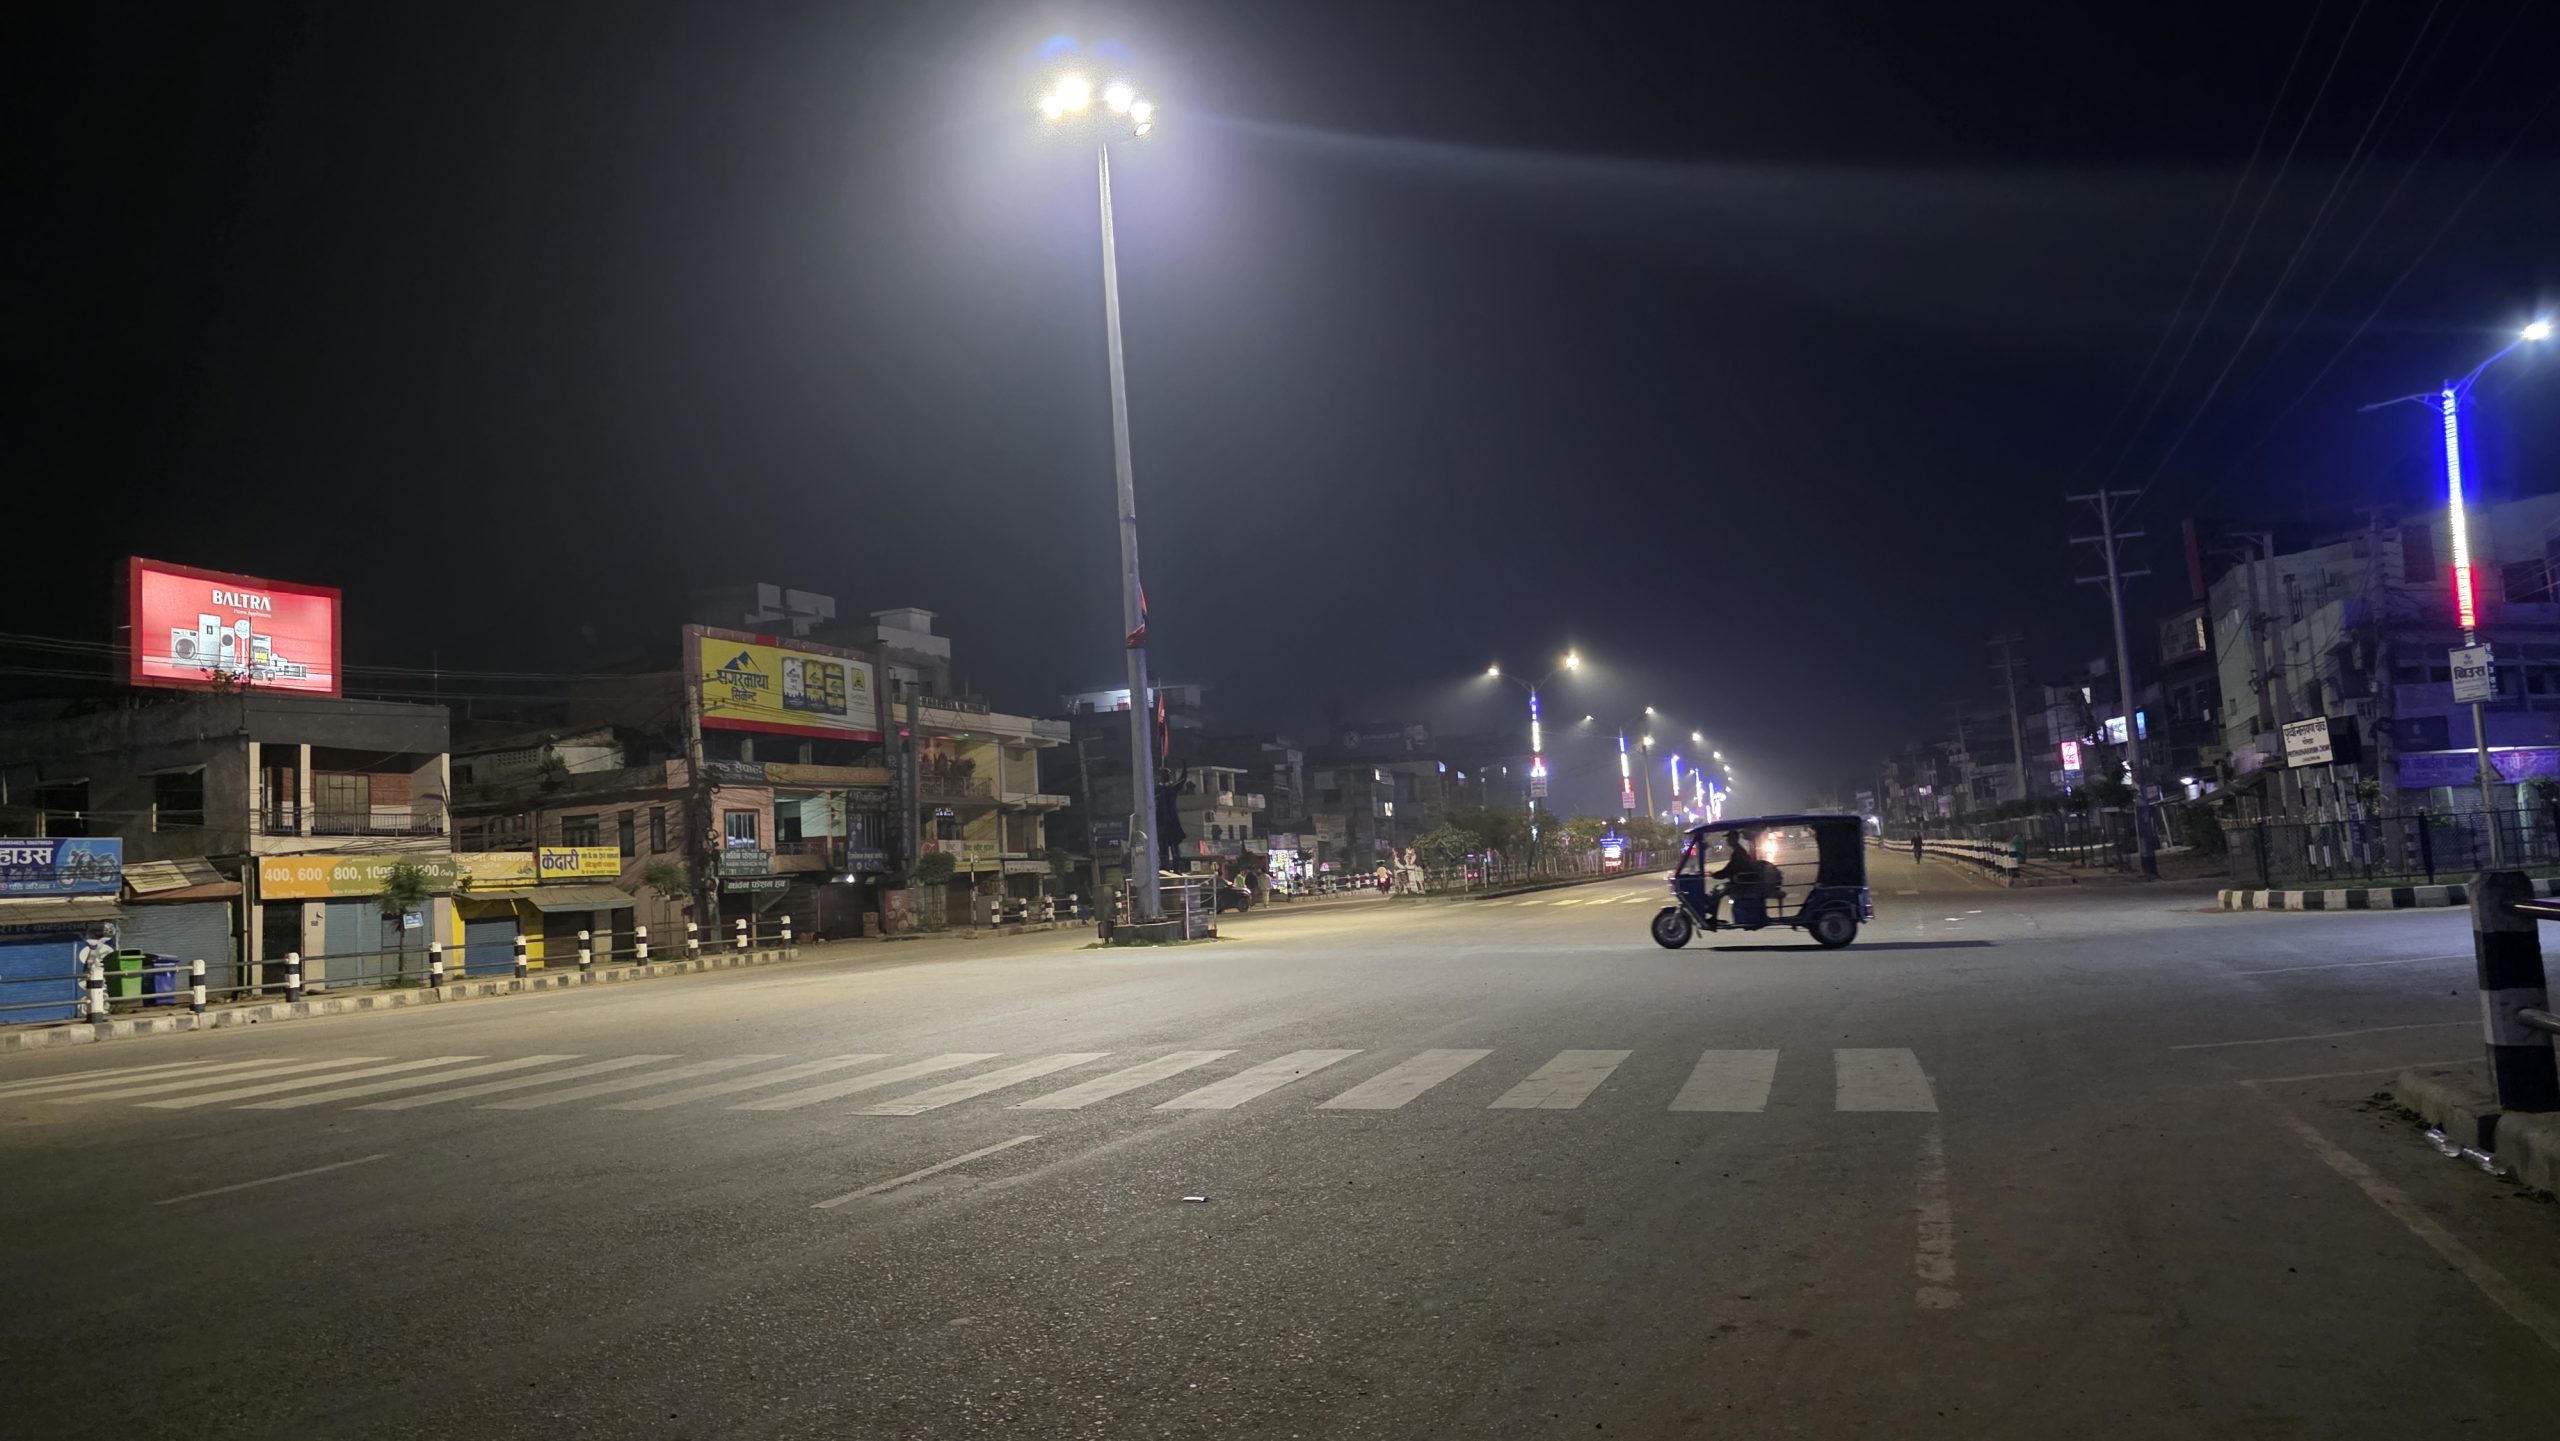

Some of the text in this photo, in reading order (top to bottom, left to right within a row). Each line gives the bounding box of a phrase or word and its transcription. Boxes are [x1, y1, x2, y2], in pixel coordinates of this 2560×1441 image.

[212, 589, 271, 611] BALTRA
[542, 849, 579, 871] केदारी
[264, 868, 294, 883] 400,
[334, 866, 362, 881] 800,
